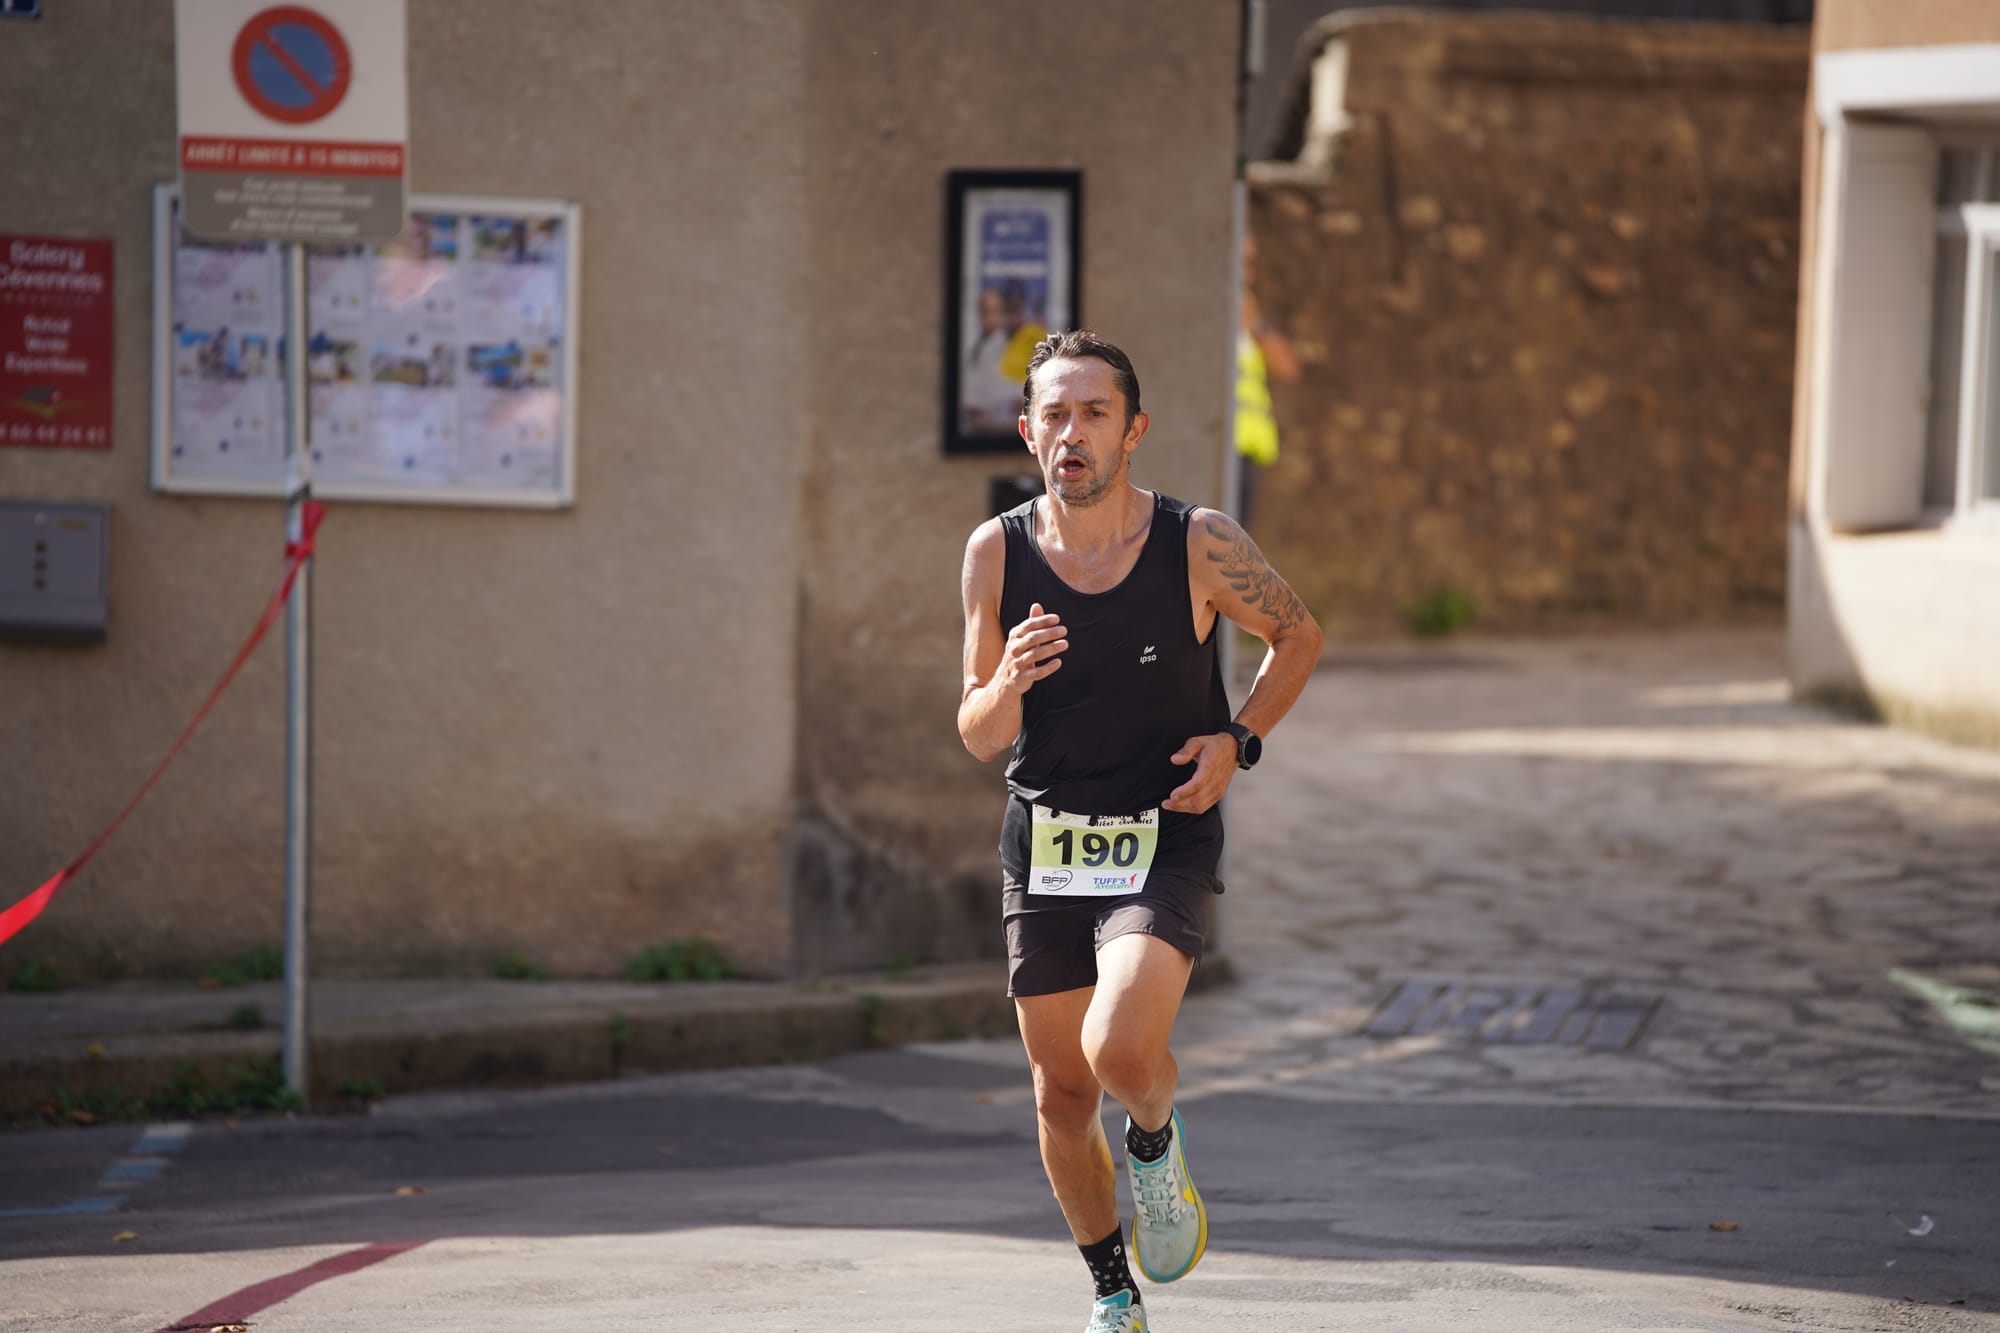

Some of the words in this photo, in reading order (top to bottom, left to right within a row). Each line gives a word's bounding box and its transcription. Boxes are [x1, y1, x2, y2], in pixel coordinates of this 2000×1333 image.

[1140, 654, 1157, 665] ipso
[1052, 829, 1139, 867] 190
[1041, 876, 1068, 884] BFP
[1093, 877, 1127, 885] TUFF'S
